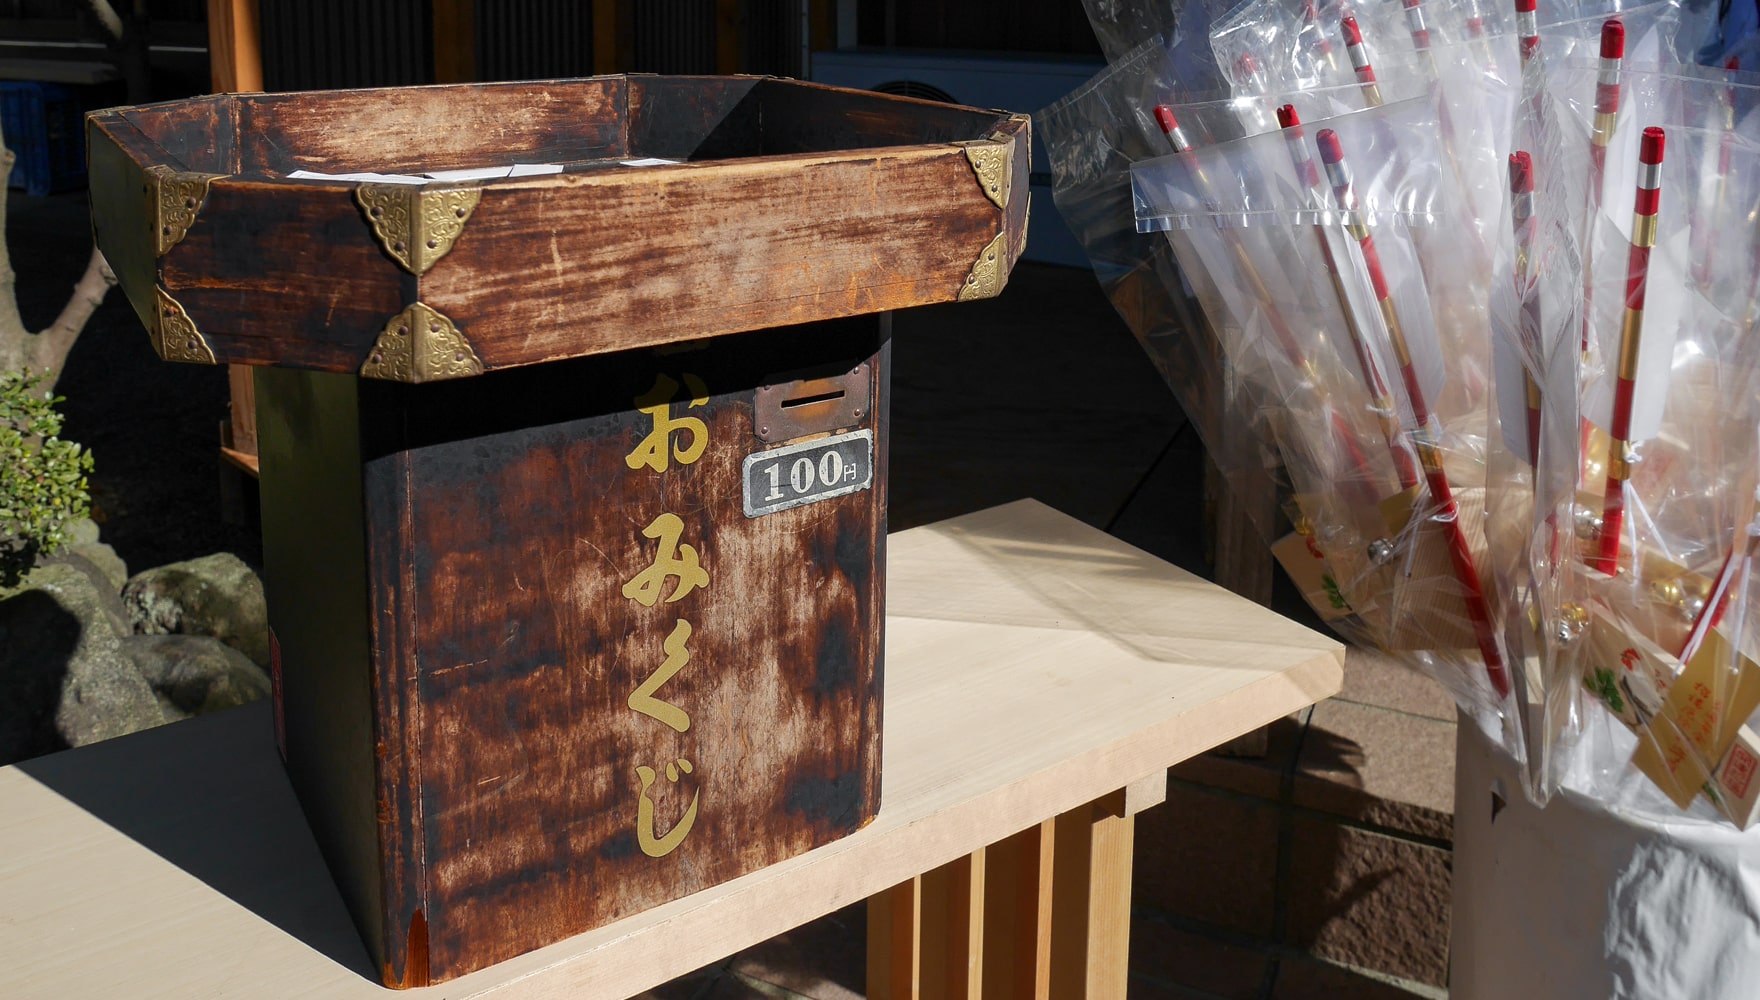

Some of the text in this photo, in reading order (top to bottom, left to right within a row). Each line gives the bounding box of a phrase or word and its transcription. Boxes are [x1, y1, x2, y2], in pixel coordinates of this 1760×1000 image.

[763, 449, 857, 502] 100円
[622, 373, 710, 858] おみくじ
